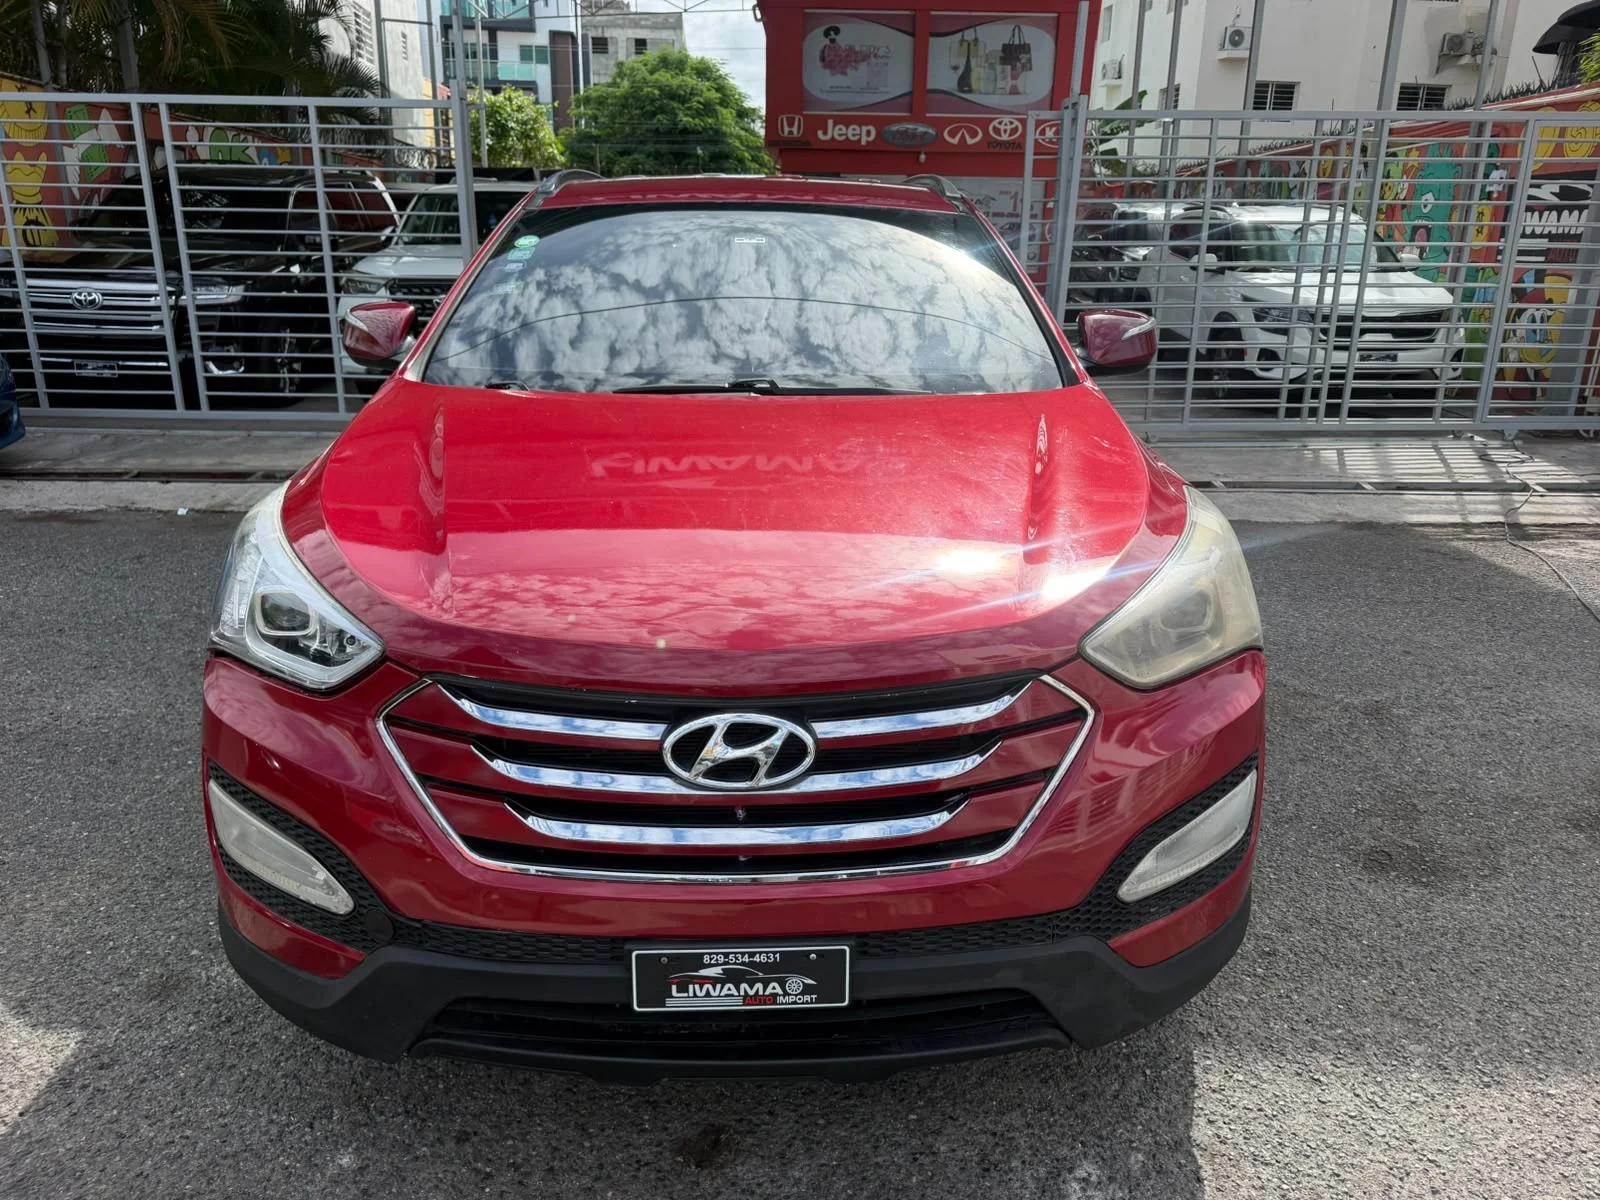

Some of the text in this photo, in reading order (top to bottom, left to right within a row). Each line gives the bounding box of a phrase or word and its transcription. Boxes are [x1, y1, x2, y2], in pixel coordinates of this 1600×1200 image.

[817, 119, 876, 145] Jeep
[987, 141, 1022, 151] TOYOTA
[703, 953, 780, 964] 829-534-4631
[671, 982, 784, 997] LIWAMA
[744, 994, 818, 1006] AUTO IMPORT
